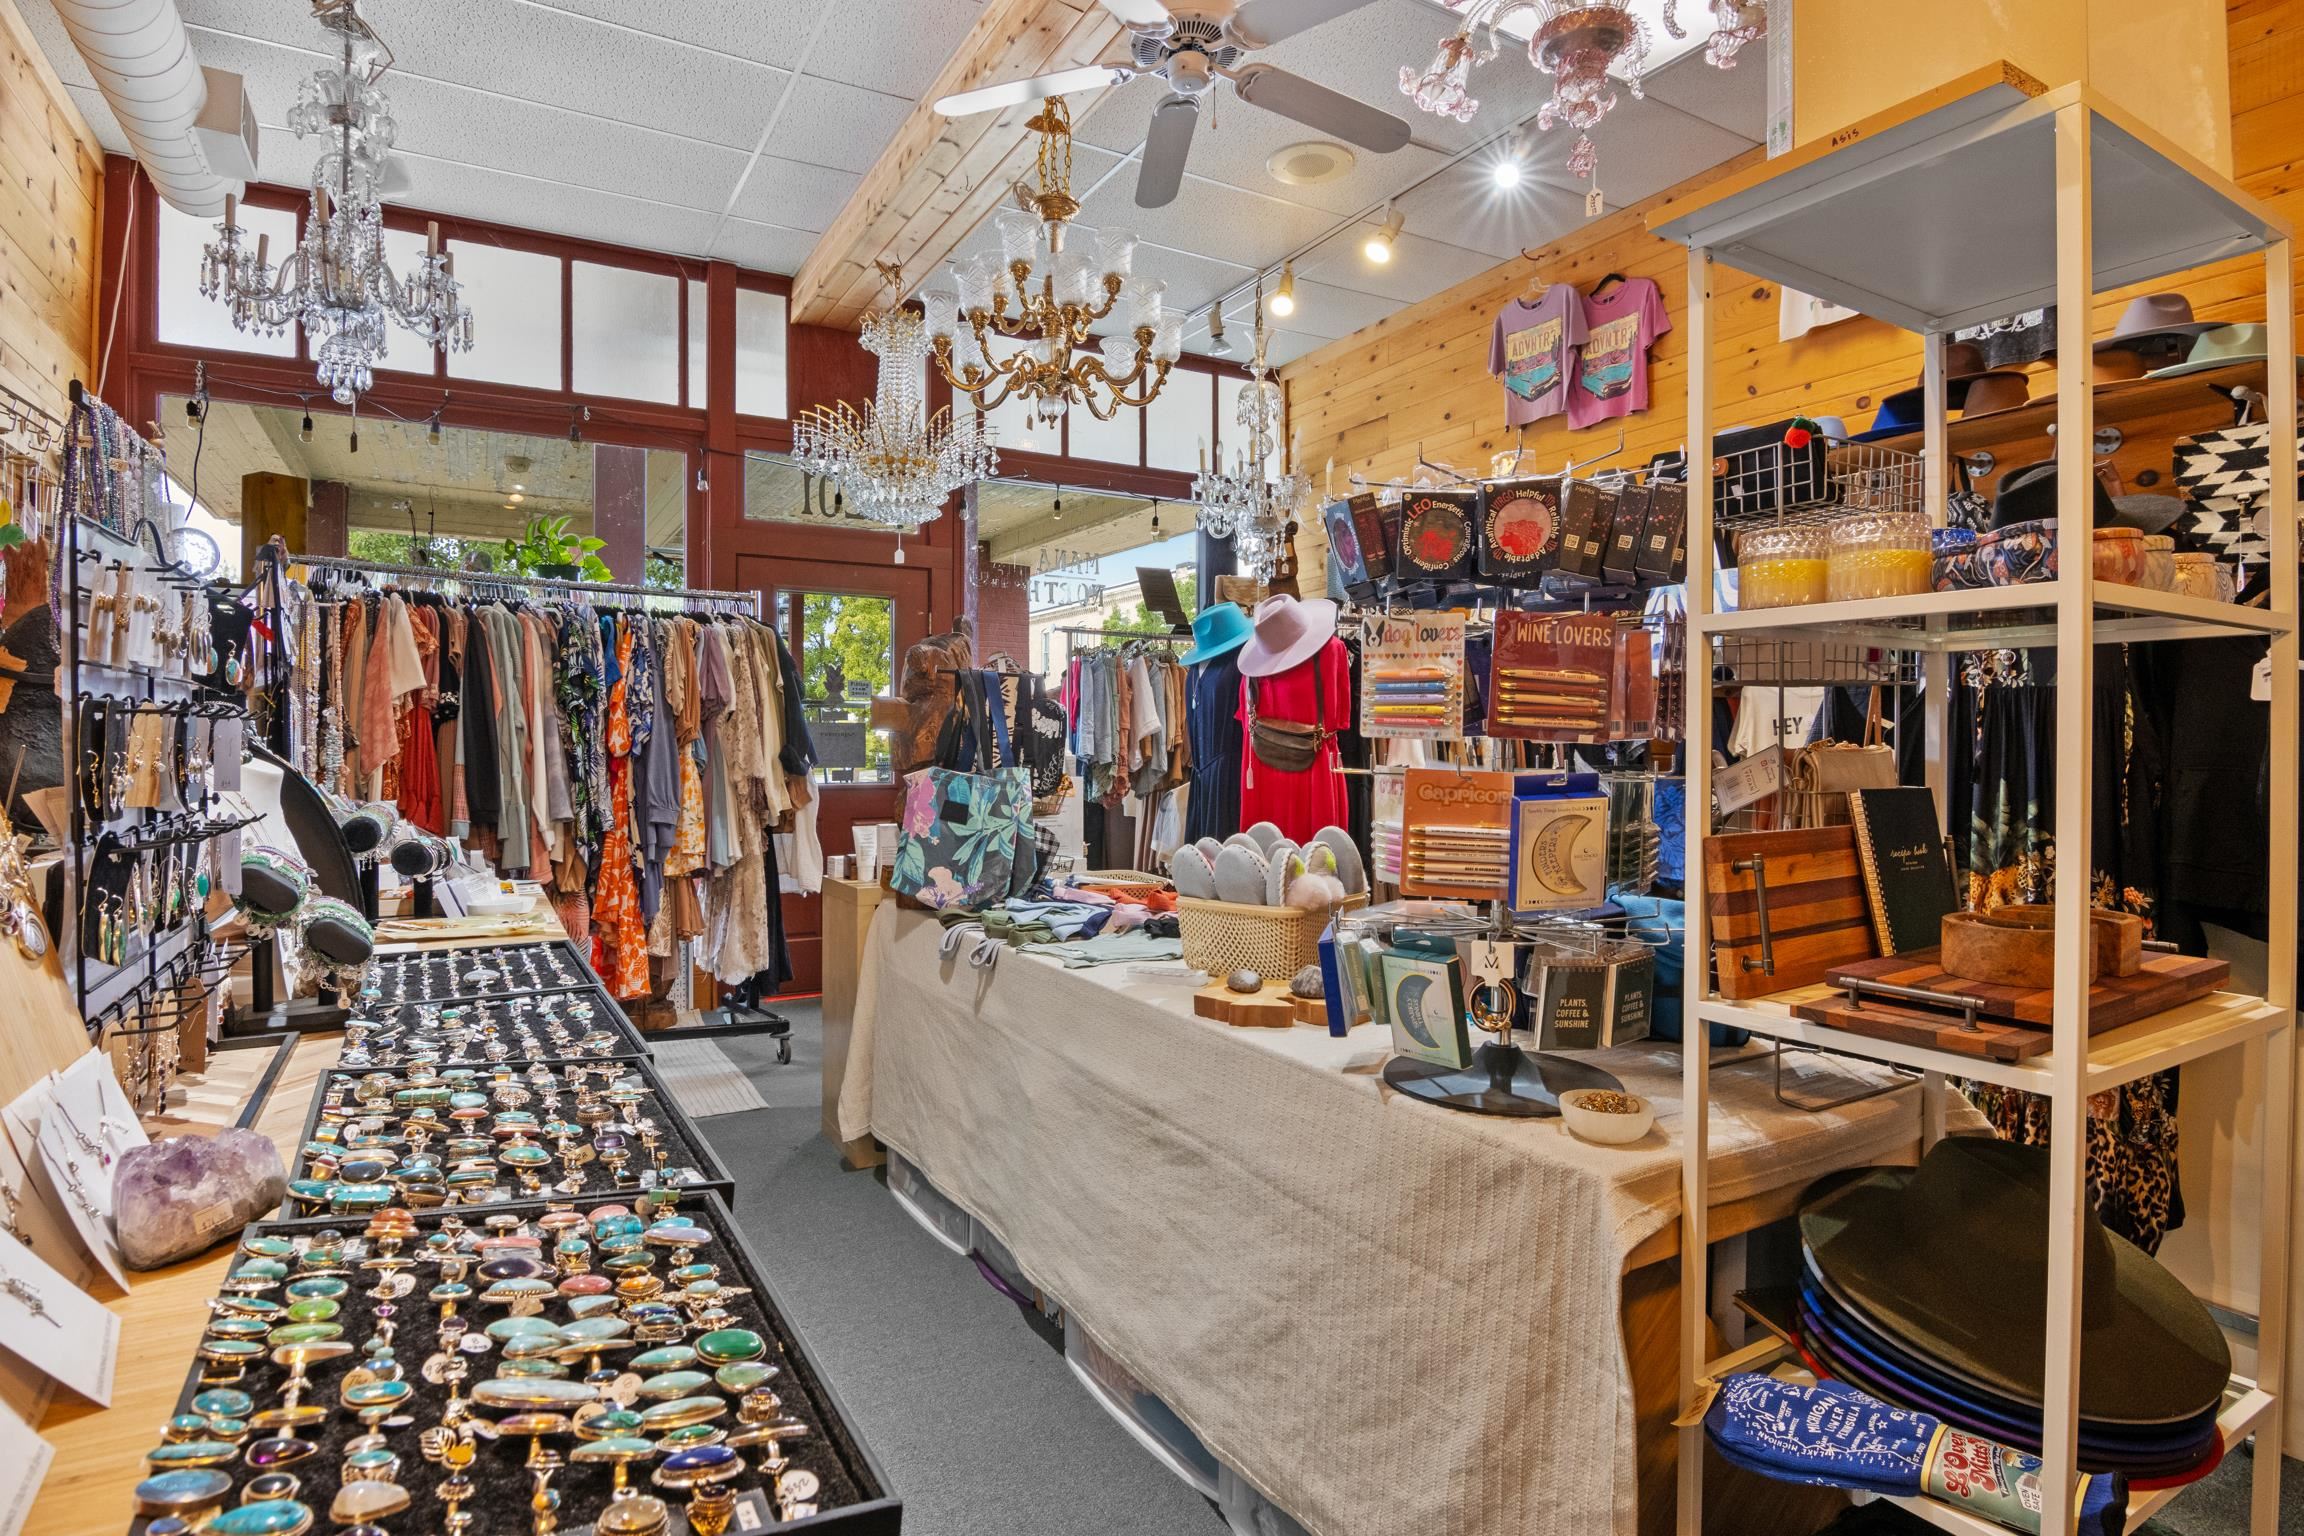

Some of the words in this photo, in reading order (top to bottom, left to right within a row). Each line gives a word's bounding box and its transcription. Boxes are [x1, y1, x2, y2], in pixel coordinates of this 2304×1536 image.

[1515, 489, 1546, 502] Helpful
[1407, 498, 1432, 519] LEO
[1432, 501, 1465, 518] Energetic
[1485, 509, 1498, 549] Analytical
[1548, 505, 1561, 539] Reliable
[1401, 518, 1414, 555] Optimistic
[1453, 521, 1472, 563] Courageous
[1413, 557, 1449, 571] Confident
[1504, 547, 1546, 563] Adaptable
[1384, 623, 1412, 648] dog
[1416, 623, 1462, 642] lovers
[1517, 622, 1552, 644] WINE
[1555, 625, 1612, 647] LOVERS
[1772, 717, 1803, 736] HEY
[1418, 783, 1511, 805] Capricor
[1556, 1009, 1581, 1017] COFFEE
[1582, 1009, 1589, 1017] &
[1621, 1010, 1644, 1024] SUNSHINE
[1622, 1003, 1639, 1013] COFFEE
[1554, 1020, 1589, 1028] SUNSHINE
[1731, 1379, 1747, 1392] LAKE
[1806, 1396, 1839, 1433] MICHIGAN
[1825, 1407, 1845, 1432] LOWER
[1836, 1406, 1861, 1440] PENINSULA
[1757, 1430, 1798, 1452] MICHIGAN
[1801, 1448, 1824, 1457] LAKE
[1943, 1432, 1971, 1498] L'Oven
[2022, 1489, 2032, 1508] OVEN
[2031, 1492, 2041, 1511] SAFE
